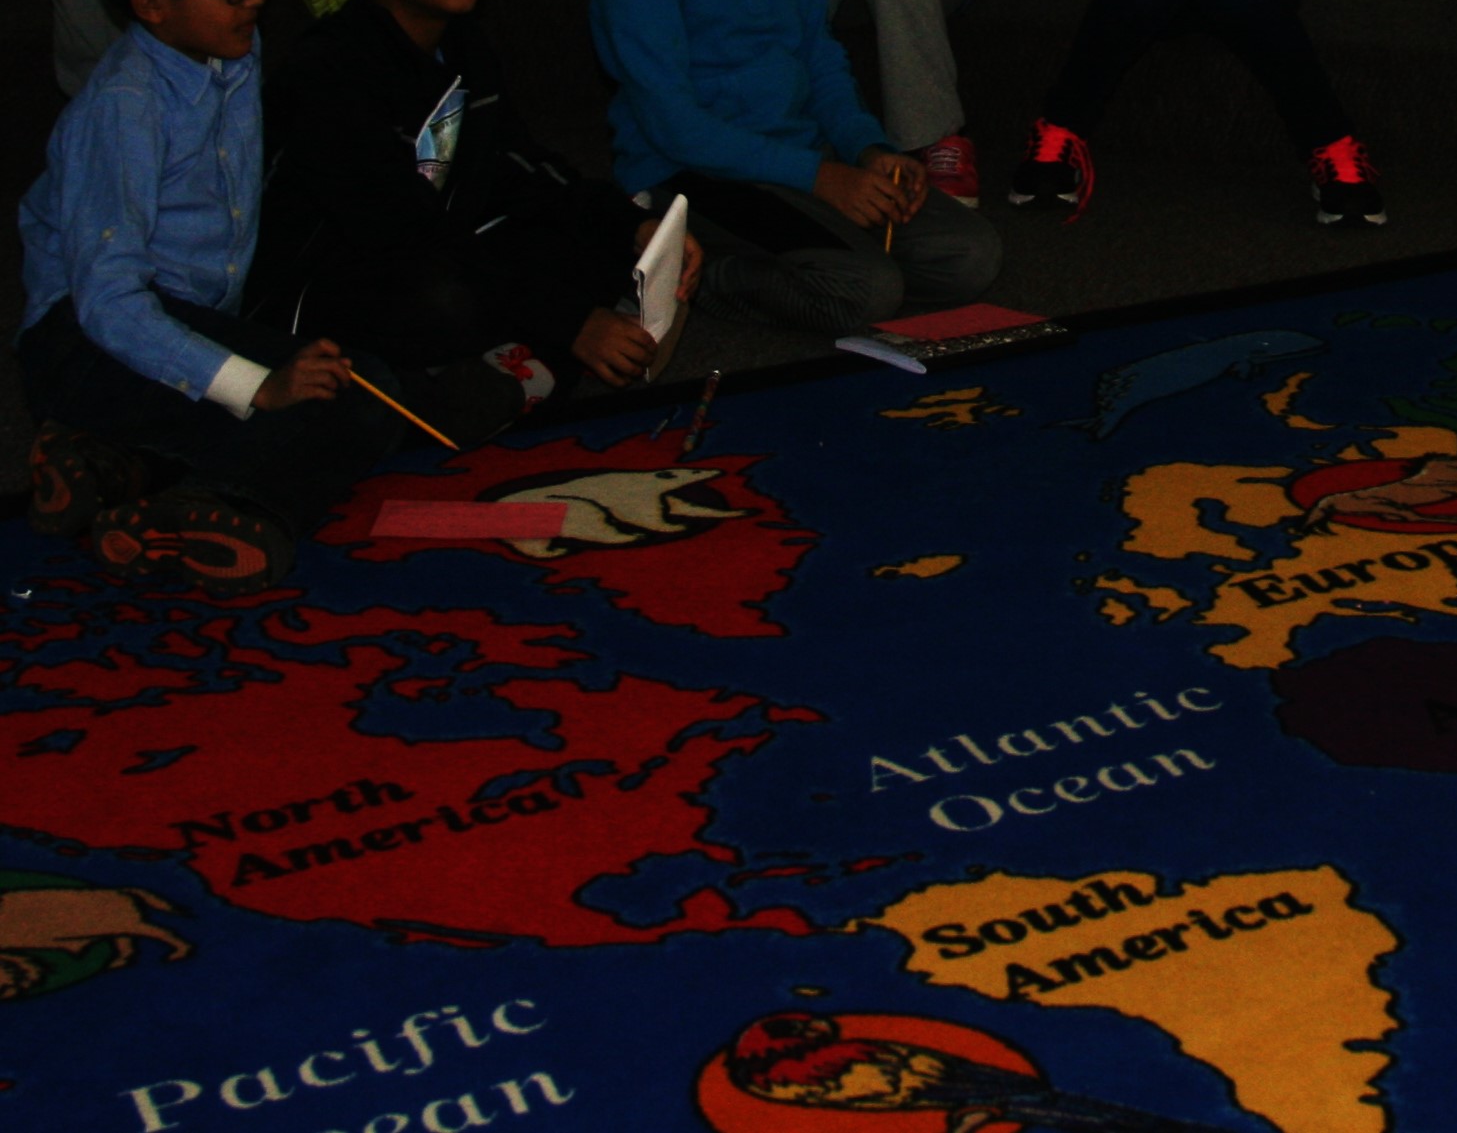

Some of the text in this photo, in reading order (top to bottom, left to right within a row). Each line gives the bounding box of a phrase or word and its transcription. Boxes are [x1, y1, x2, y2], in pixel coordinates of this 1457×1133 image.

[869, 687, 1224, 793] Atlantic
[168, 779, 414, 849] North
[928, 748, 1217, 832] Ocean
[230, 791, 560, 887] America
[922, 880, 1155, 960] South
[1004, 892, 1314, 1002] America
[116, 998, 548, 1133] Pacific
[318, 1071, 577, 1133] ean
